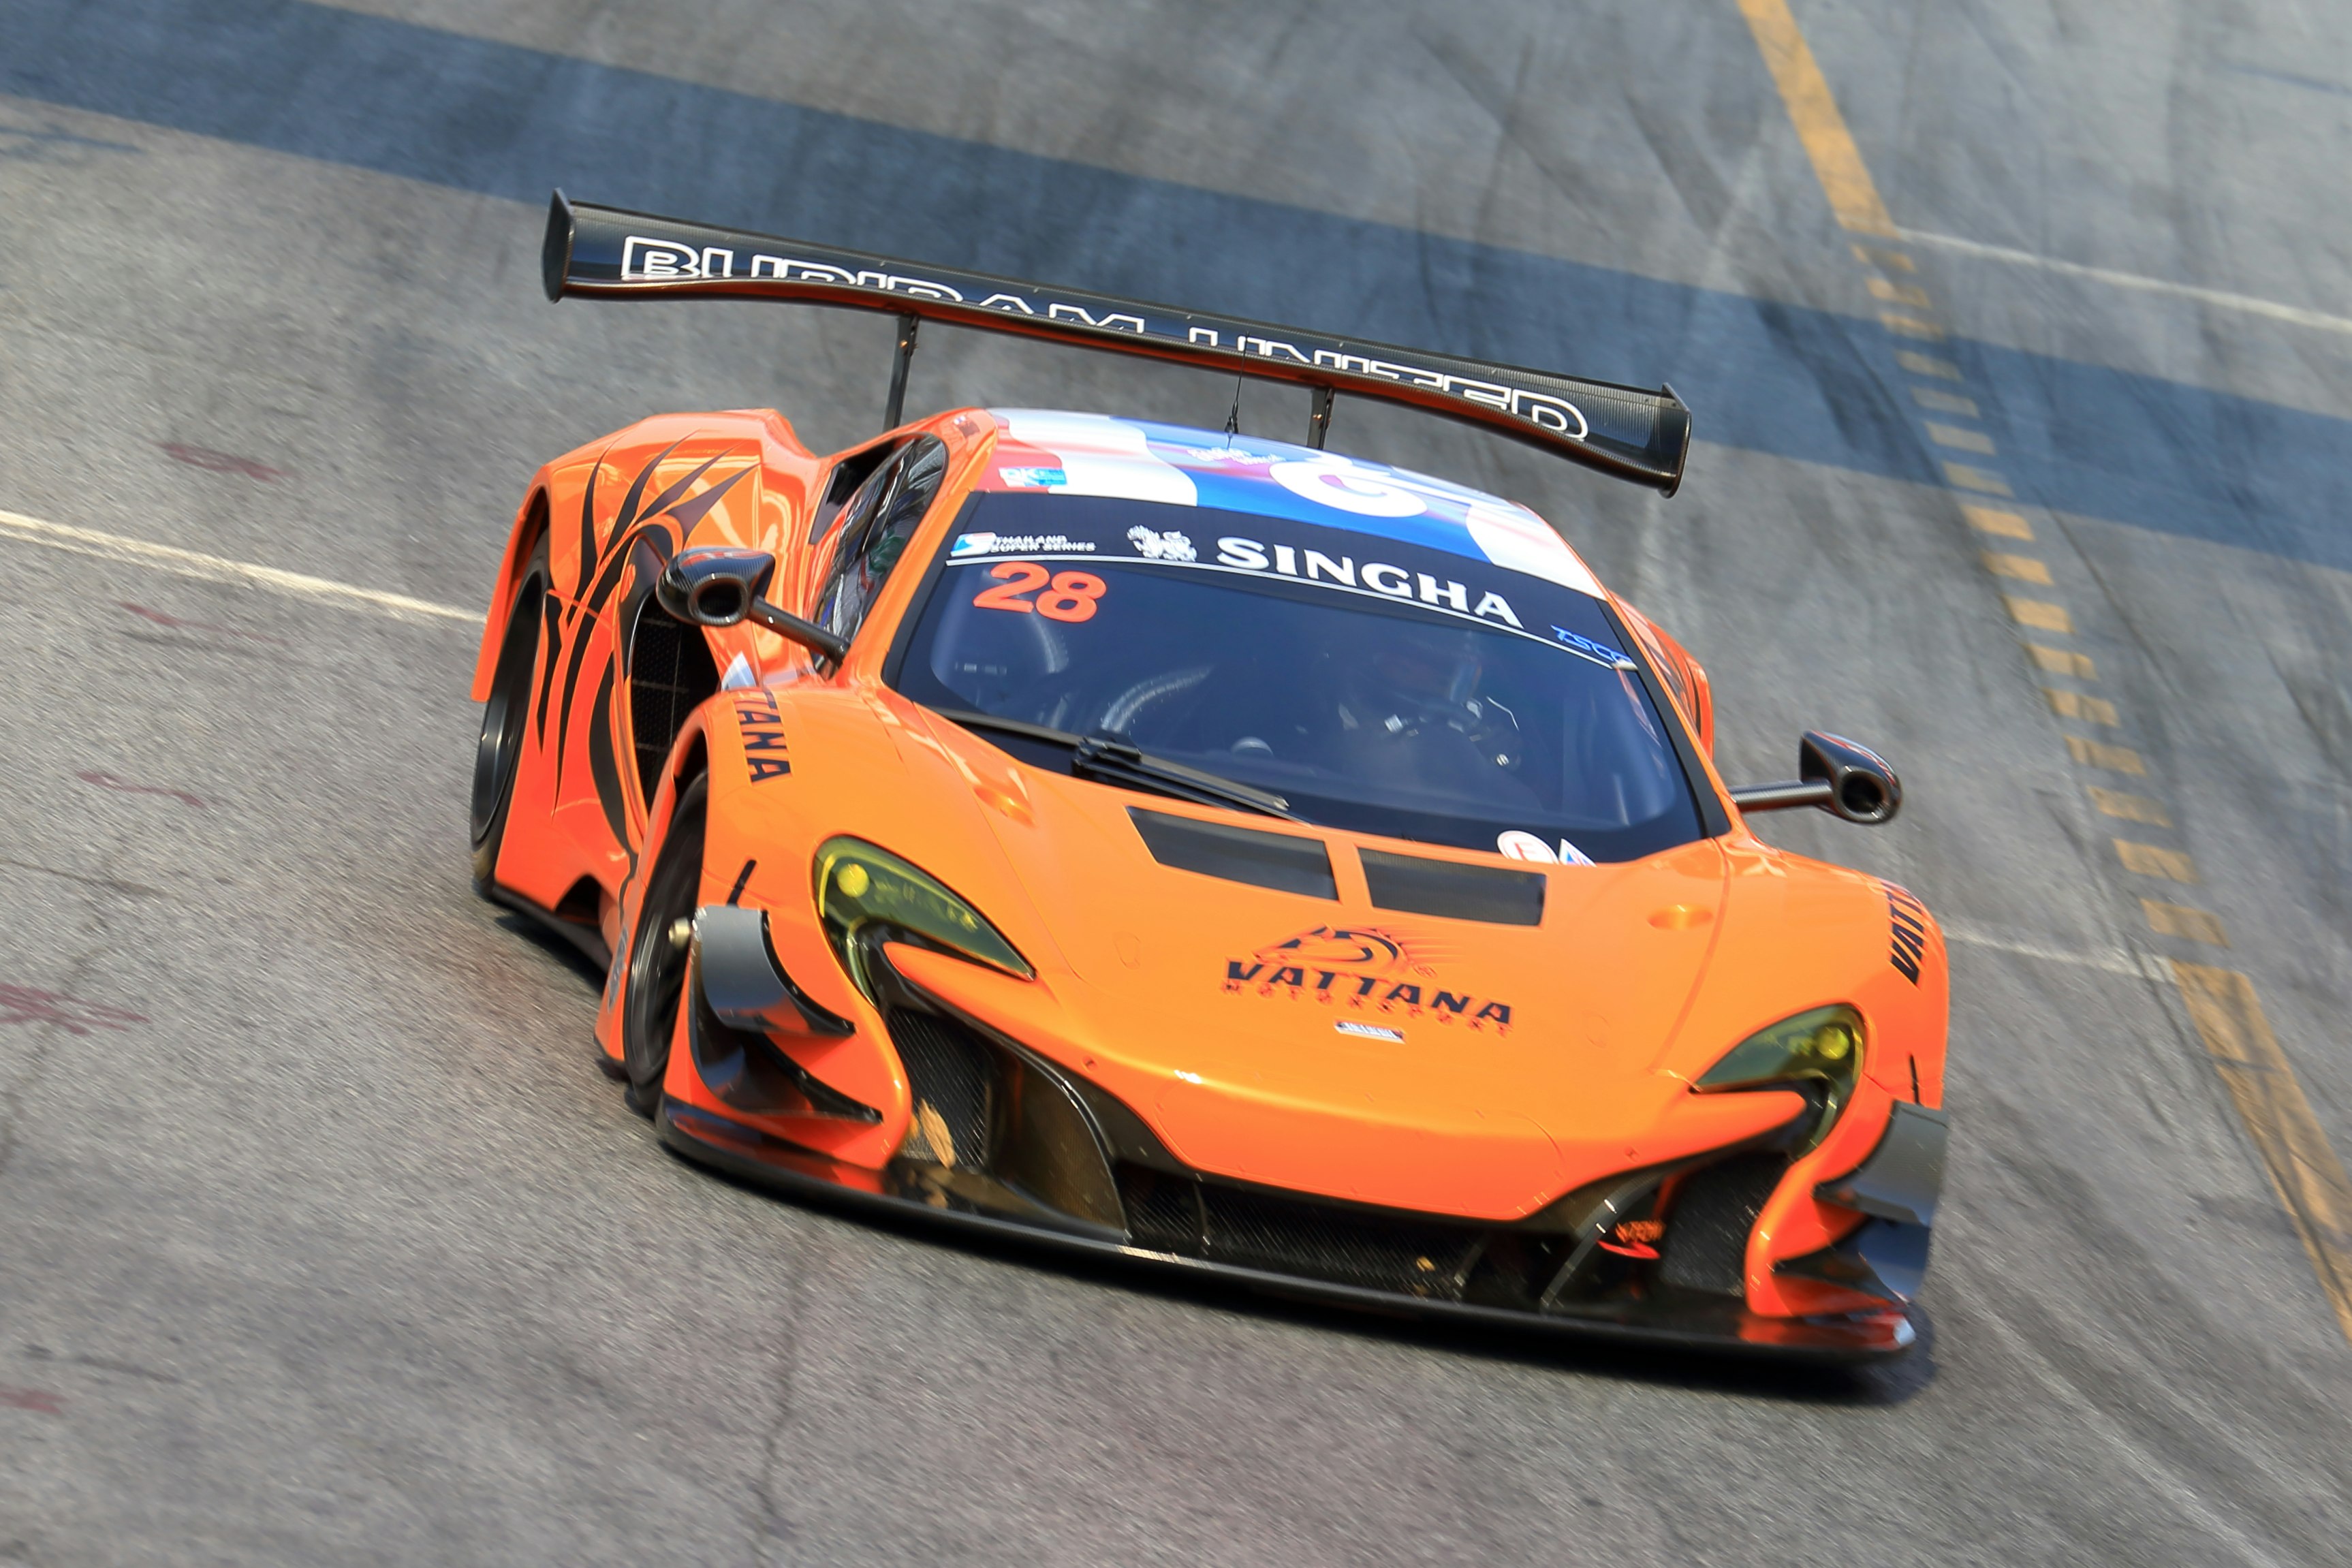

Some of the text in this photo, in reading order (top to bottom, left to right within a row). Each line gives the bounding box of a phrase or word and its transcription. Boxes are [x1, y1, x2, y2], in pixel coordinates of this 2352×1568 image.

[990, 542, 1095, 552] SUPER SERIES
[996, 535, 1067, 545] THAILAND
[973, 561, 1106, 623] 28
[1217, 537, 1524, 629] SINGHA
[1227, 961, 1511, 1024] VATTANA
